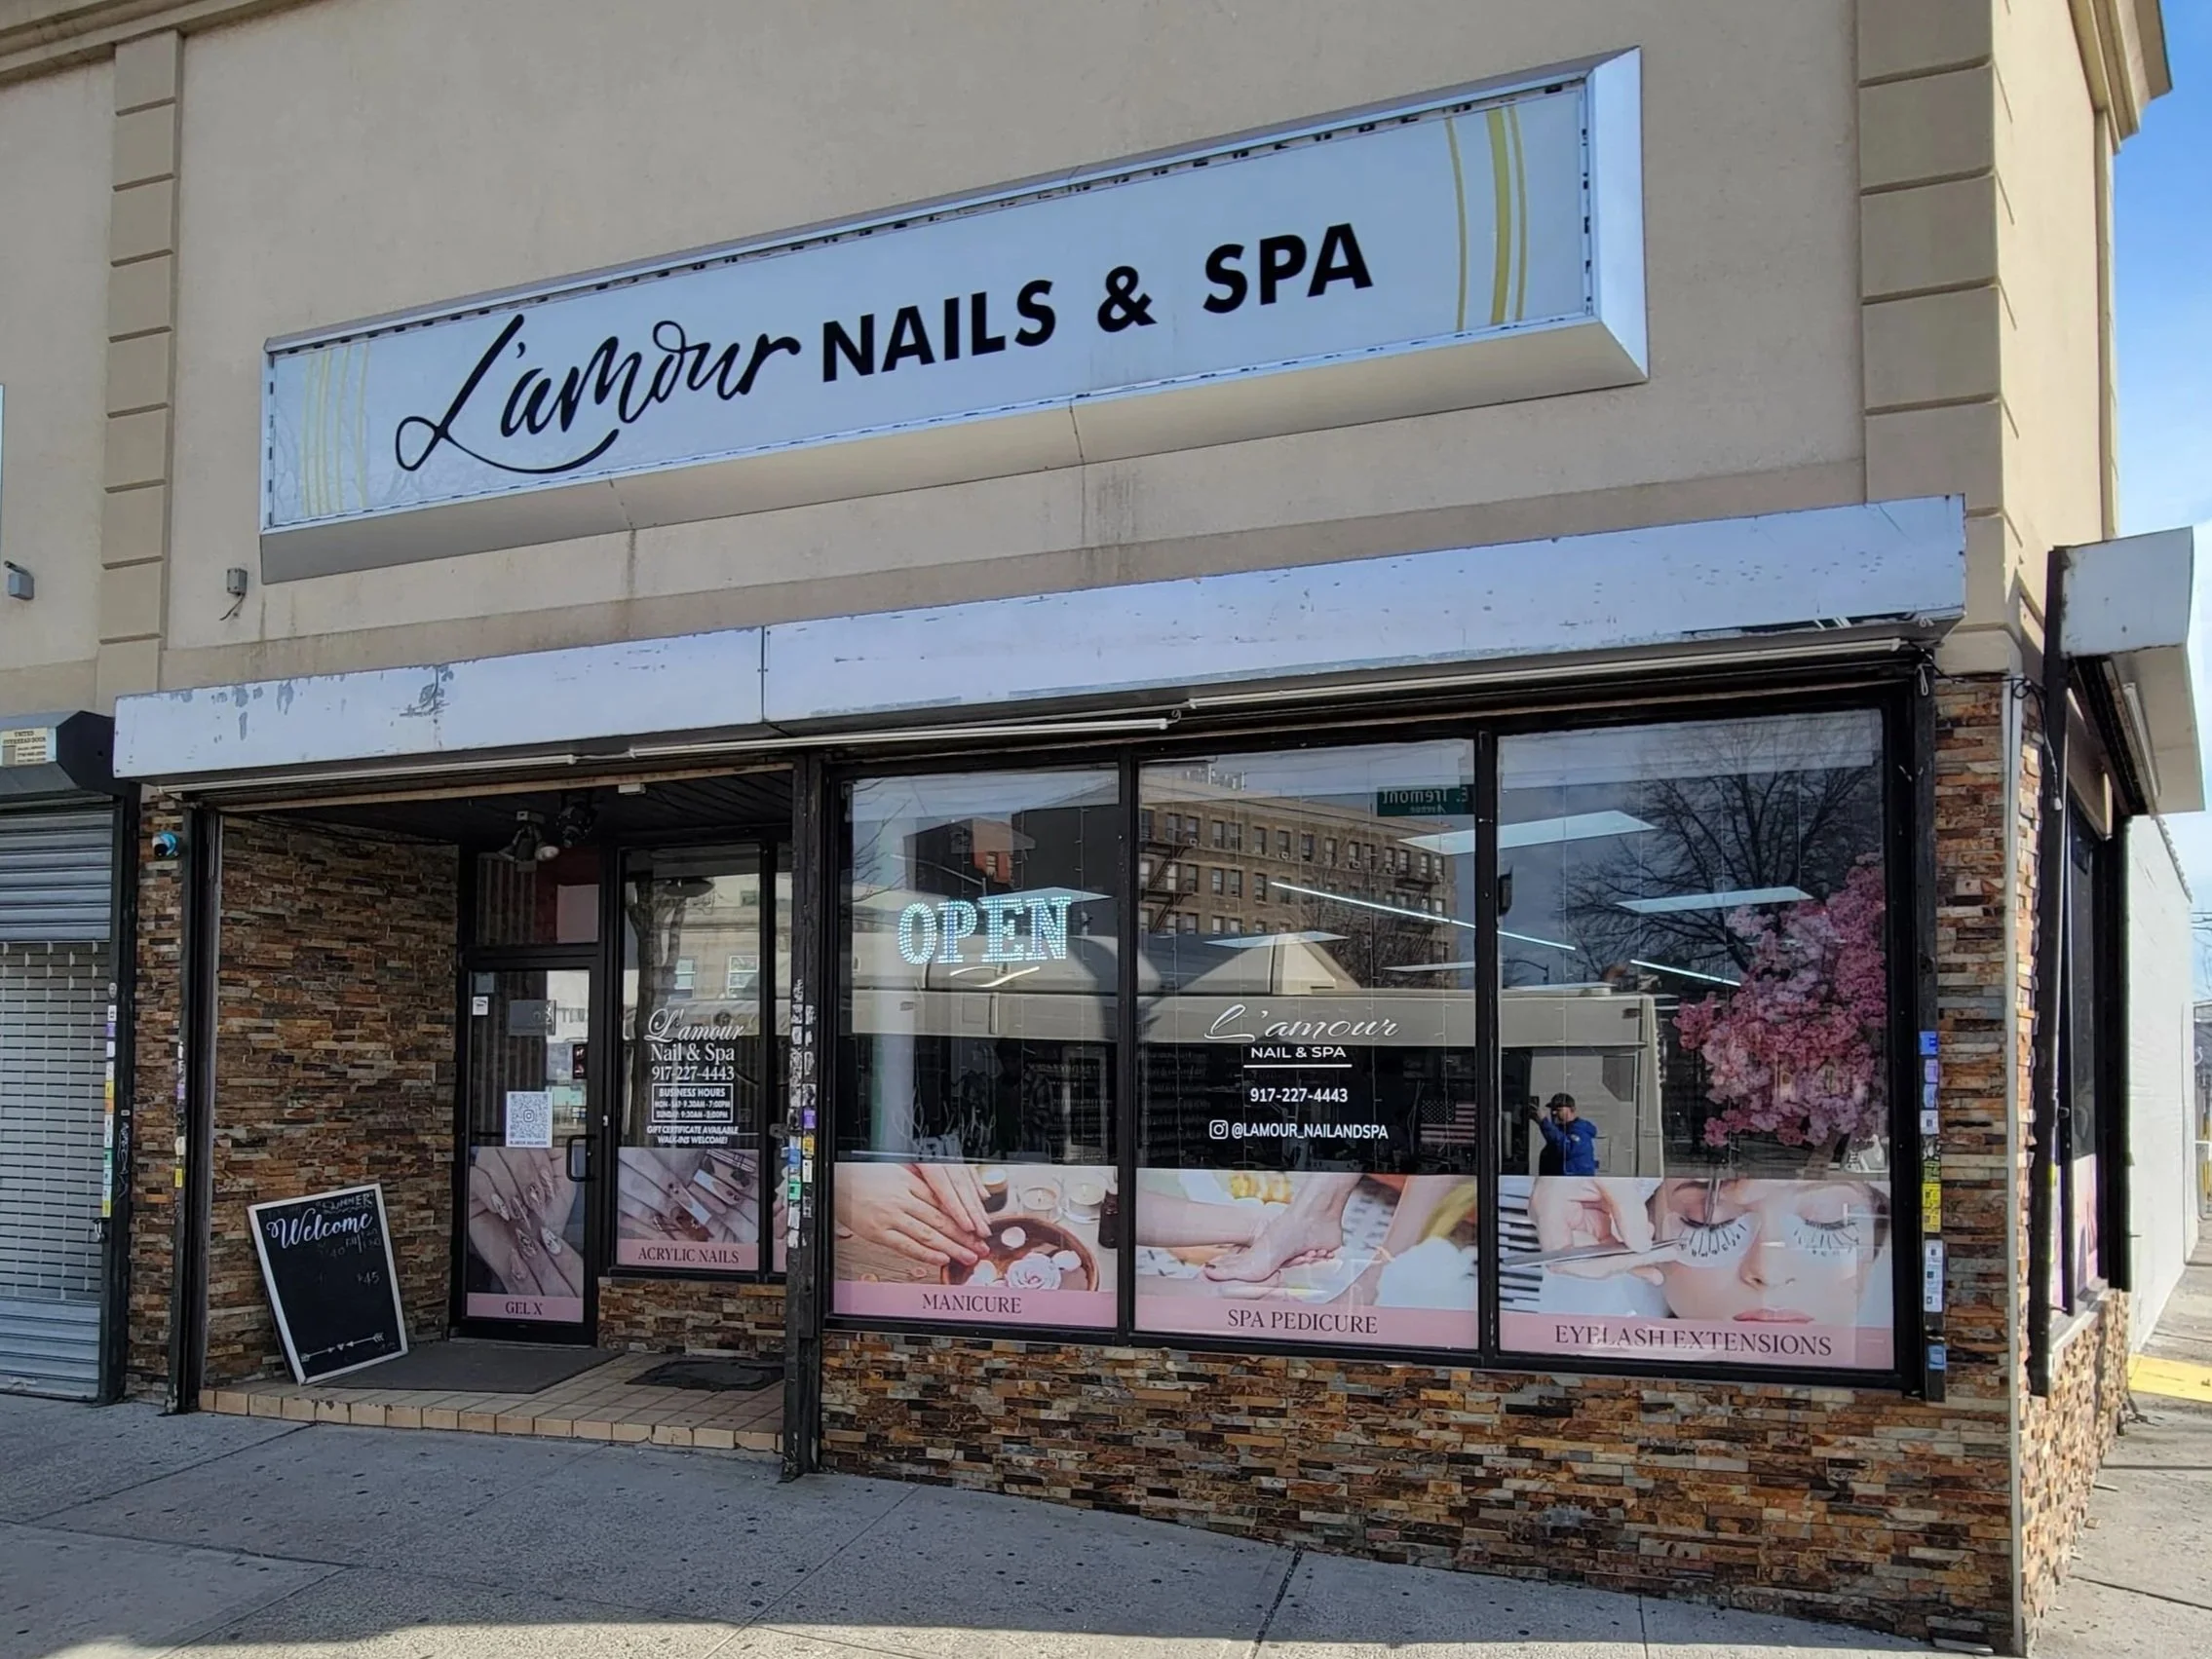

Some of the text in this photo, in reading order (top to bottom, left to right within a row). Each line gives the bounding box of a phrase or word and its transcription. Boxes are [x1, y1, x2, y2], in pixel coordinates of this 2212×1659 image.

[395, 223, 1374, 473] L'amour NAILS & SPA
[897, 896, 1072, 964] OPEN
[644, 1008, 744, 1042] L'amour
[1204, 1003, 1399, 1042] L'amour
[651, 1042, 735, 1066] Nail & Spa
[1251, 1046, 1347, 1059] NAIL & SPA
[652, 1065, 735, 1081] 917-227-4443
[659, 1087, 725, 1098] BUSINESS HOURS
[1250, 1087, 1349, 1103] 917-227-4443
[646, 1125, 739, 1135] GIFT CERTIFICATE AVAILABLE
[1232, 1122, 1389, 1139] @LAMOUR_NAILANDSPA
[266, 1208, 373, 1249] Welcome
[637, 1247, 740, 1264] ACRYLIC NAILS
[505, 1301, 544, 1316] GEL X
[922, 1293, 1022, 1314] MANICURE
[1227, 1308, 1378, 1335] SPA PEDICURE
[1554, 1324, 1833, 1356] EYELASH EXTENSIONS
